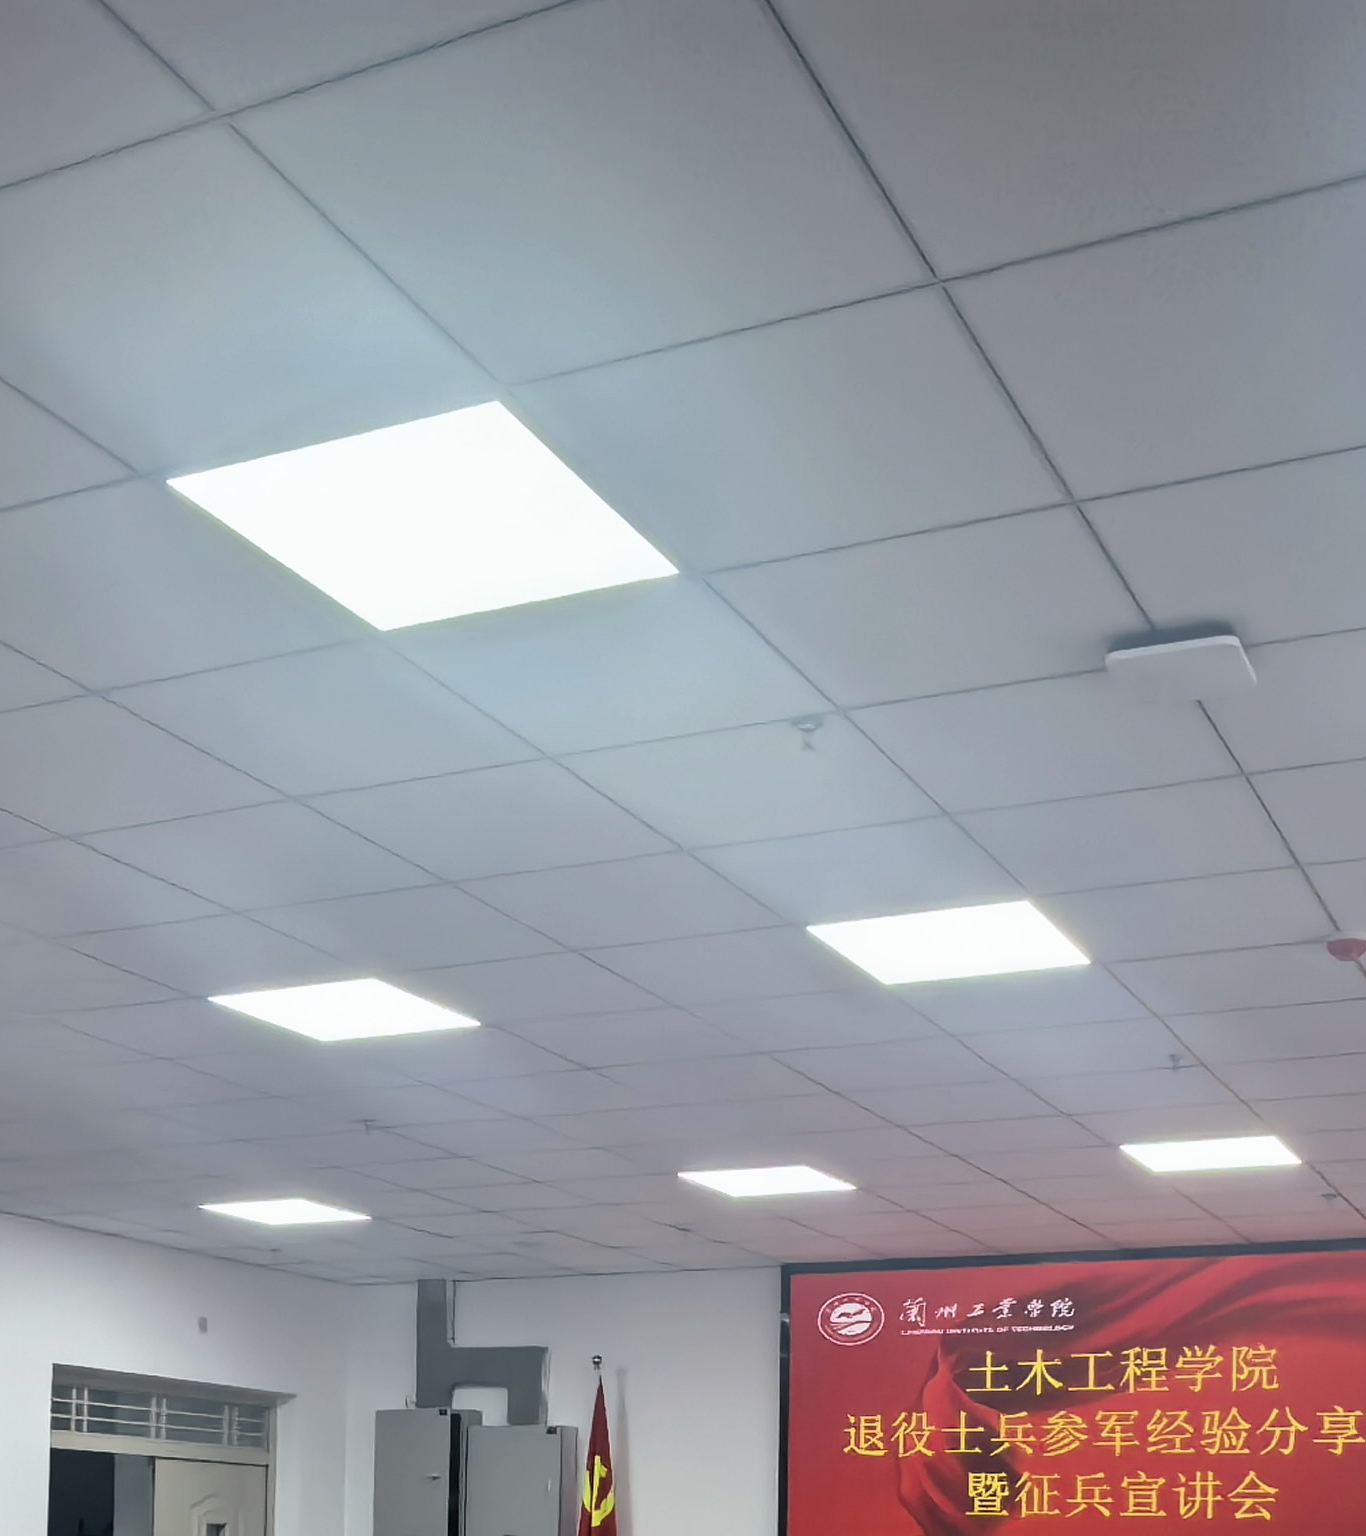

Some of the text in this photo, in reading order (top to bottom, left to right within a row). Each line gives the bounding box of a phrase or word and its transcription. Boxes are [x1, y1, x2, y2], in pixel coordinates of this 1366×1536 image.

[966, 1344, 1280, 1396] 土木工程学院
[965, 1470, 1280, 1521] 暨征兵宣讲会
